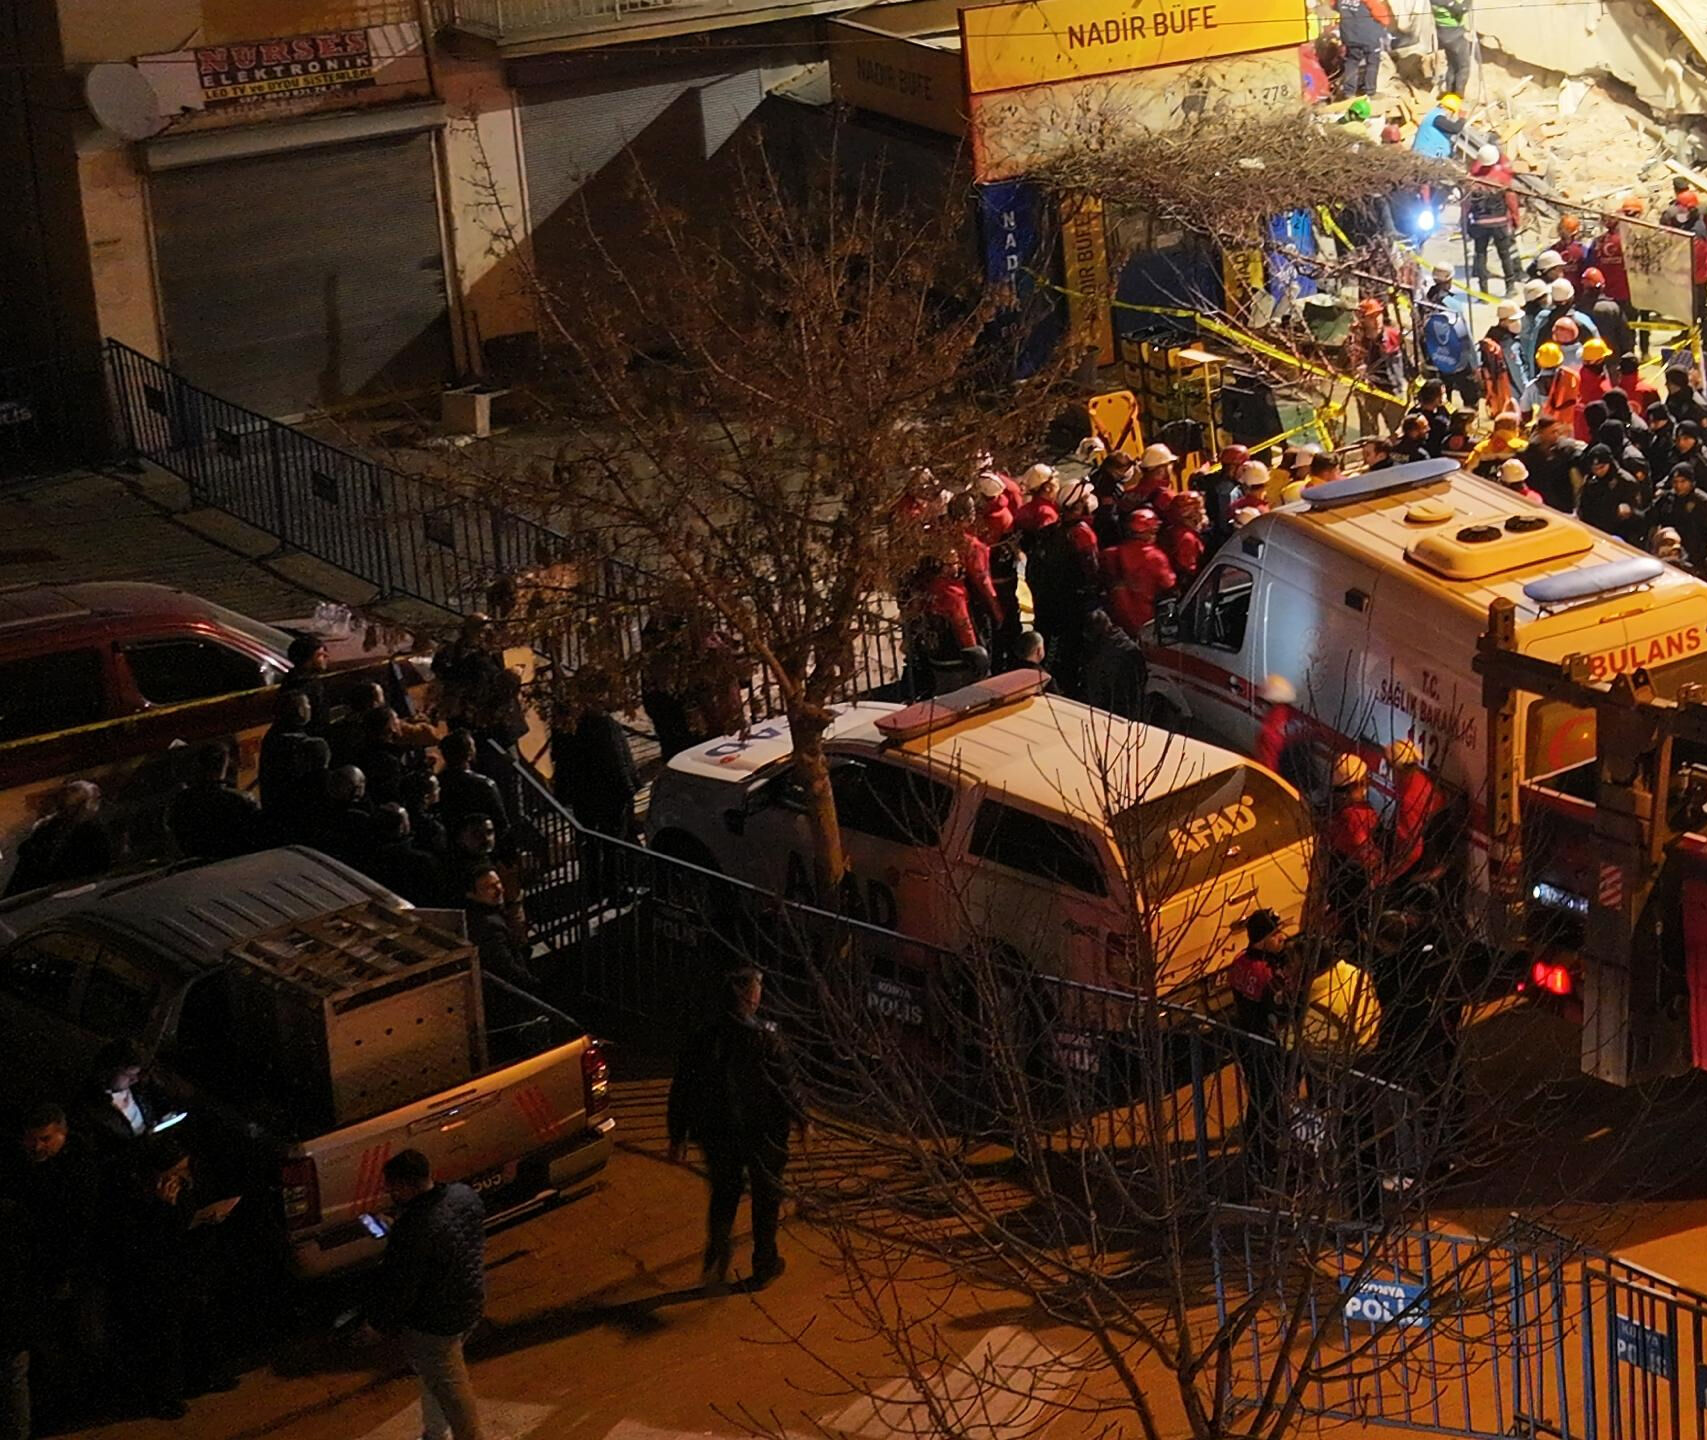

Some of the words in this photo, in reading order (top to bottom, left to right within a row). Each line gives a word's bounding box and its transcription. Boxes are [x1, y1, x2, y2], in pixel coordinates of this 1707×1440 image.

[1068, 11, 1147, 50] NADİR
[1151, 2, 1219, 37] BÜFE
[198, 31, 369, 75] NURSES
